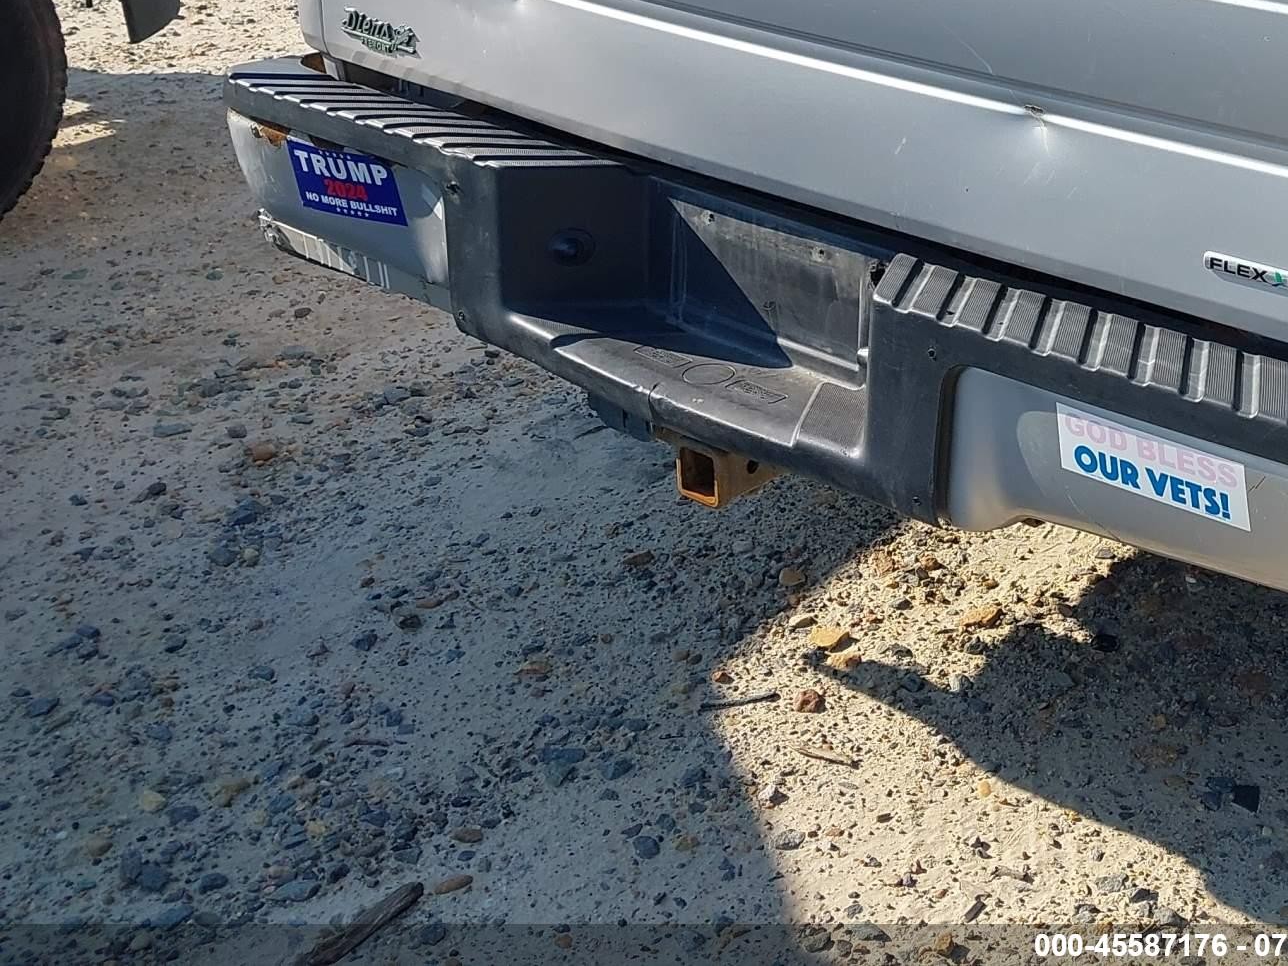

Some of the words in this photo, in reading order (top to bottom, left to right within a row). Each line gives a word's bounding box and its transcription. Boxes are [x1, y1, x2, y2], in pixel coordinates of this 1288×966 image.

[293, 149, 388, 186] TRUMP
[305, 191, 320, 203] NO
[321, 195, 349, 209] MORE
[349, 200, 398, 216] BULLSHIT
[1209, 257, 1268, 283] FLEX
[1064, 414, 1128, 452] GOD
[1135, 435, 1239, 489] BLESS
[1074, 445, 1141, 490] OUR
[1145, 466, 1232, 520] VETS!
